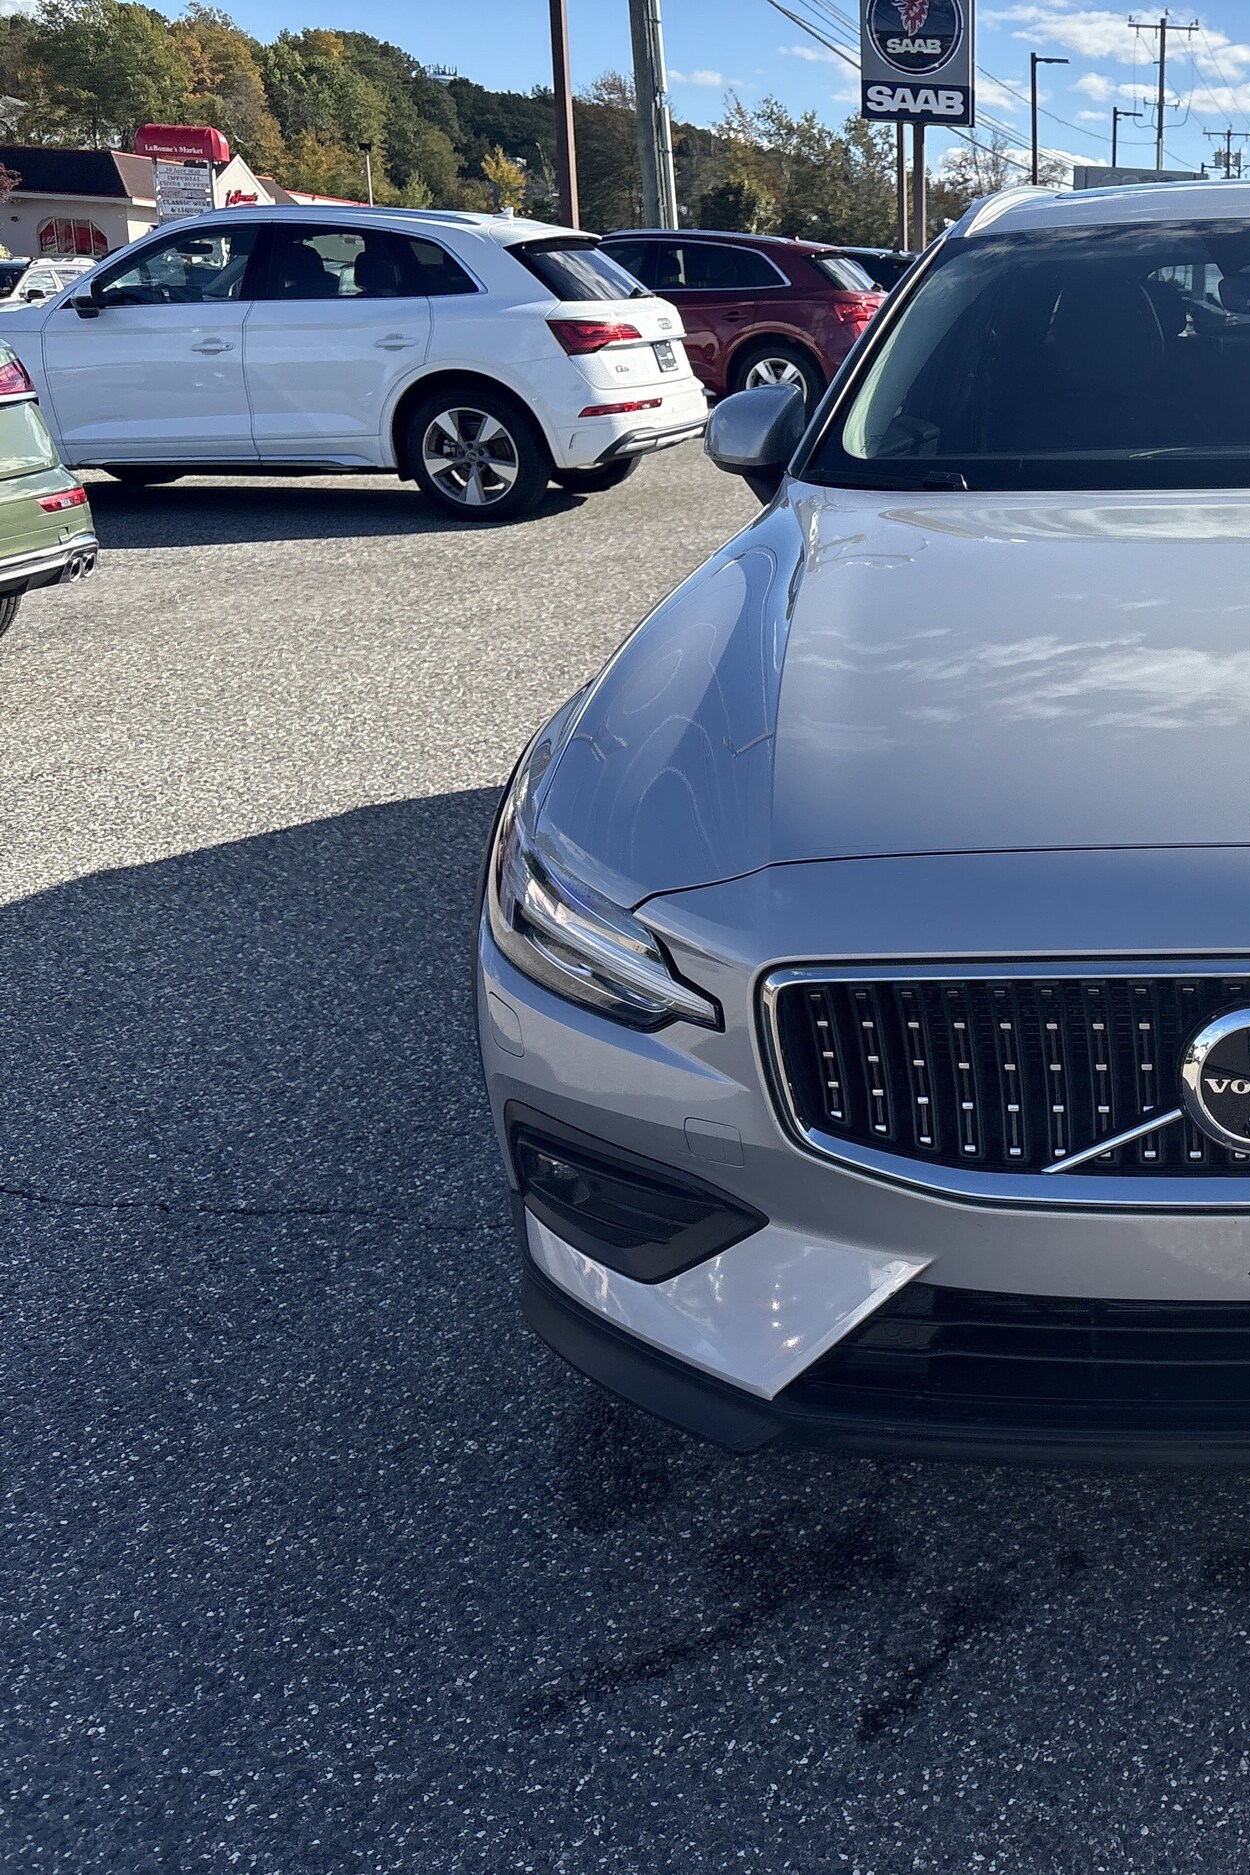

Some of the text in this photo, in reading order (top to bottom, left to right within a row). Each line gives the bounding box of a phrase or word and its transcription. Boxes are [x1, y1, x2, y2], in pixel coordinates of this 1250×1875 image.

[886, 38, 942, 54] SAAB
[866, 85, 965, 116] SAAB
[144, 144, 203, 154] LaBonne's Market
